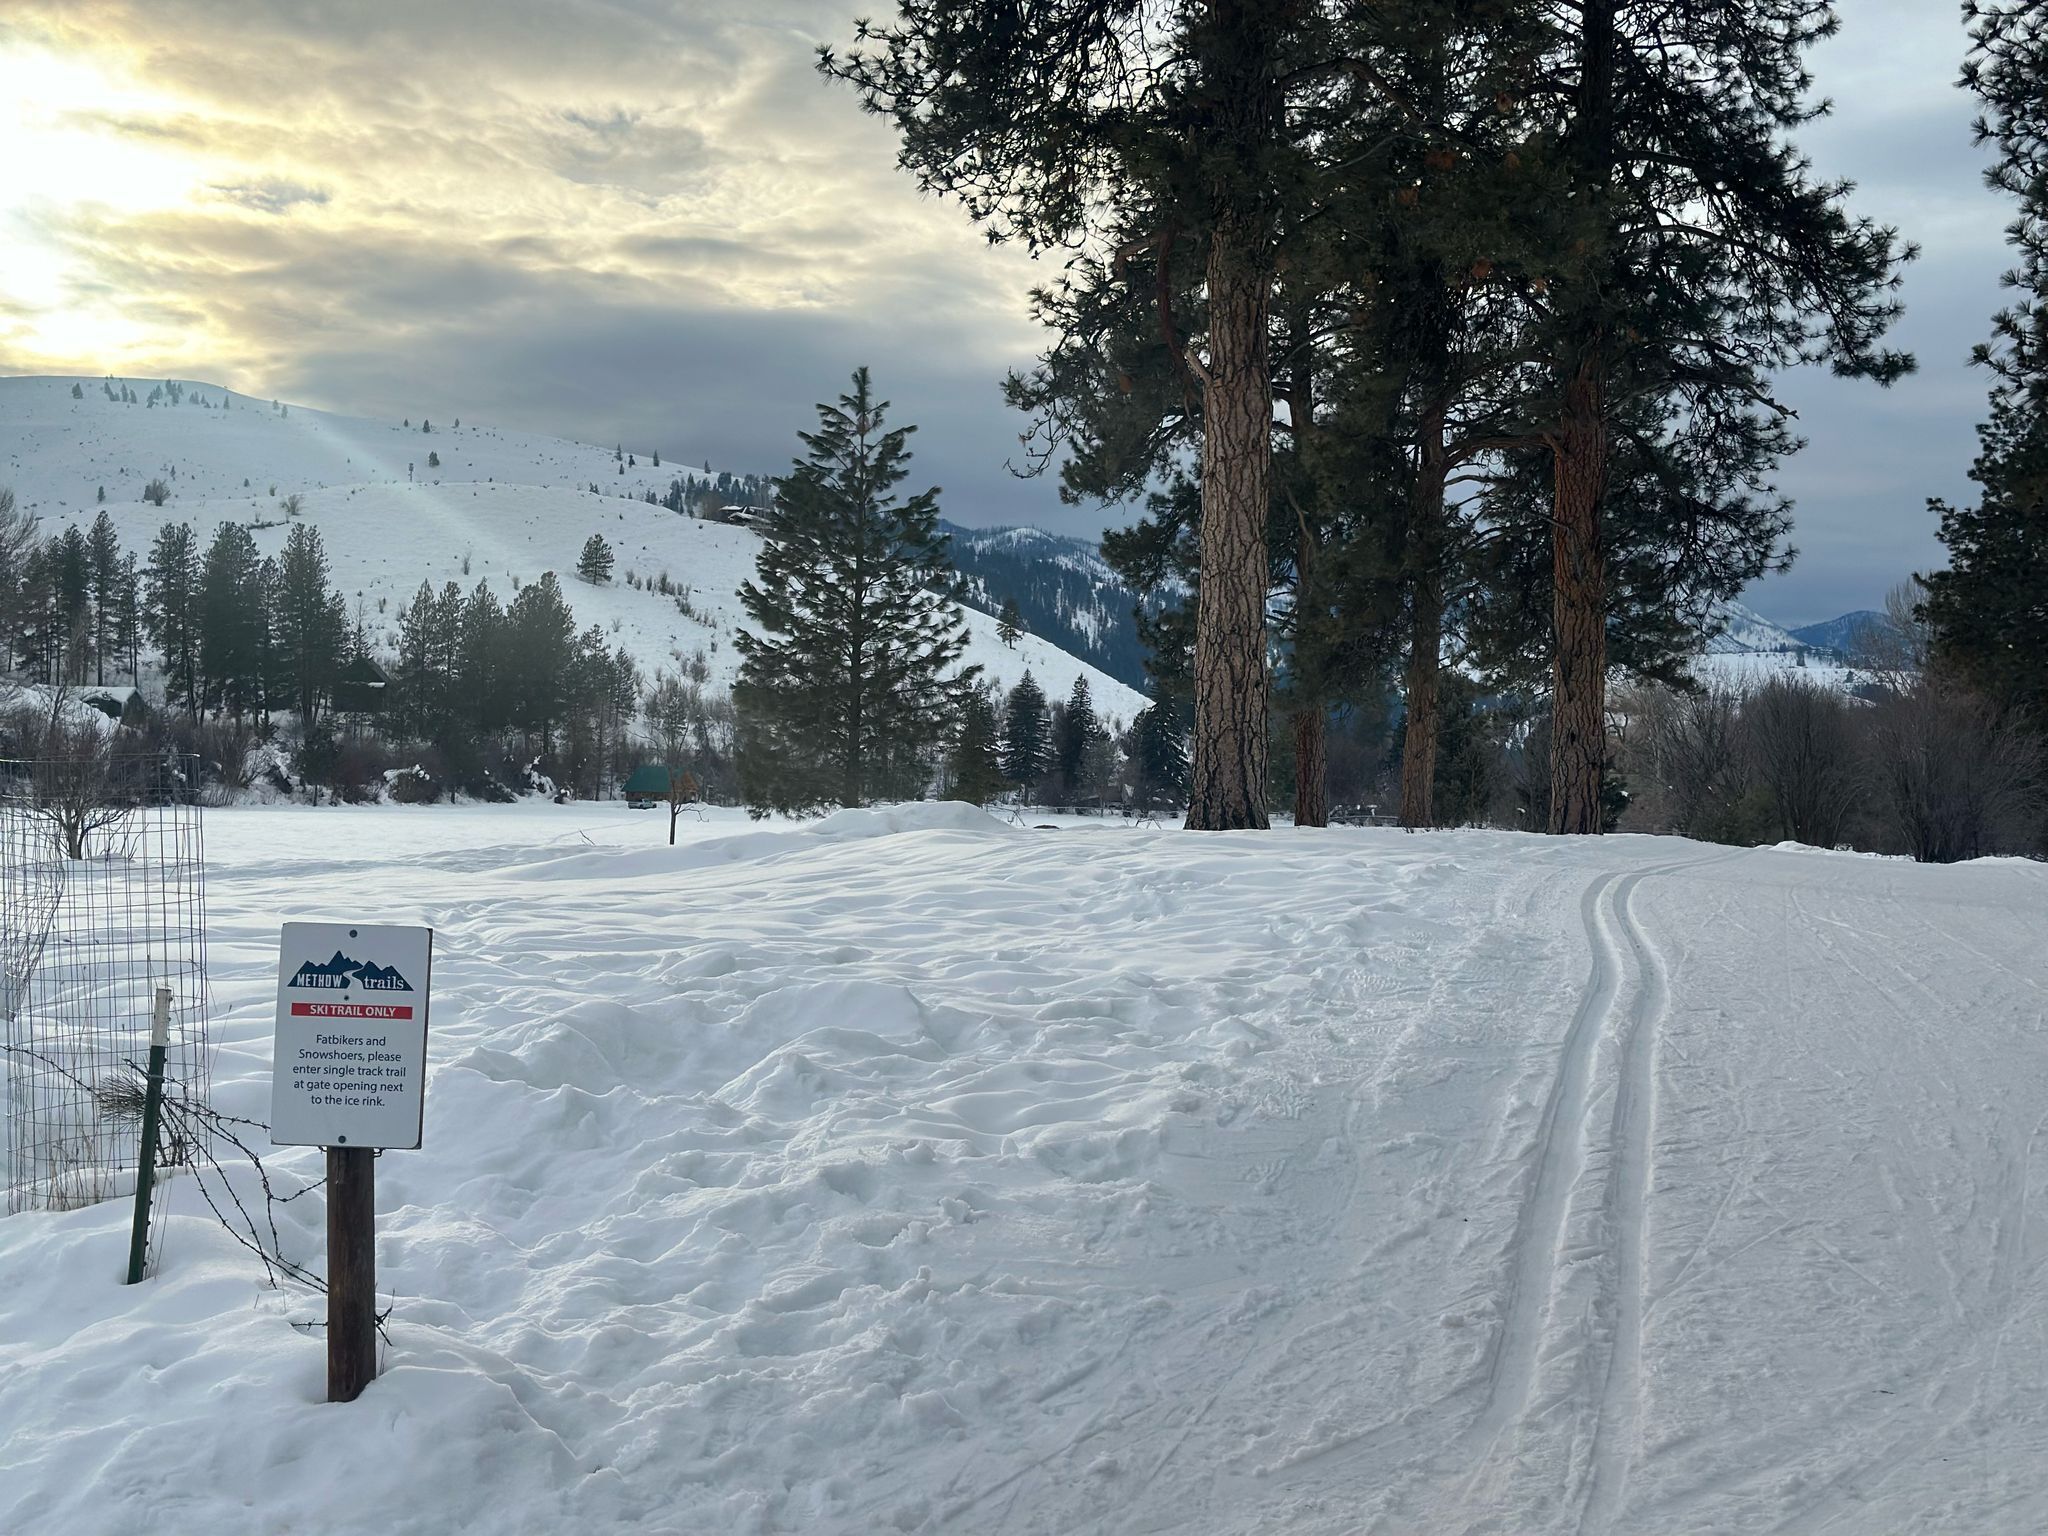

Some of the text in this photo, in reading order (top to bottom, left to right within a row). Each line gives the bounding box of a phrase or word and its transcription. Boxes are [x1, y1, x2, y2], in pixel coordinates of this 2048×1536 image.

[297, 974, 404, 989] METHOW trails
[310, 1005, 396, 1017] SKI TRAIL ONLY
[316, 1035, 386, 1046] Fatbikers and
[299, 1049, 401, 1062] Snowshoers, please
[324, 1065, 355, 1077] single
[358, 1066, 383, 1076] track
[386, 1067, 406, 1076] trail
[294, 1080, 403, 1093] at gate opening next
[311, 1095, 385, 1106] to the ice rink.
